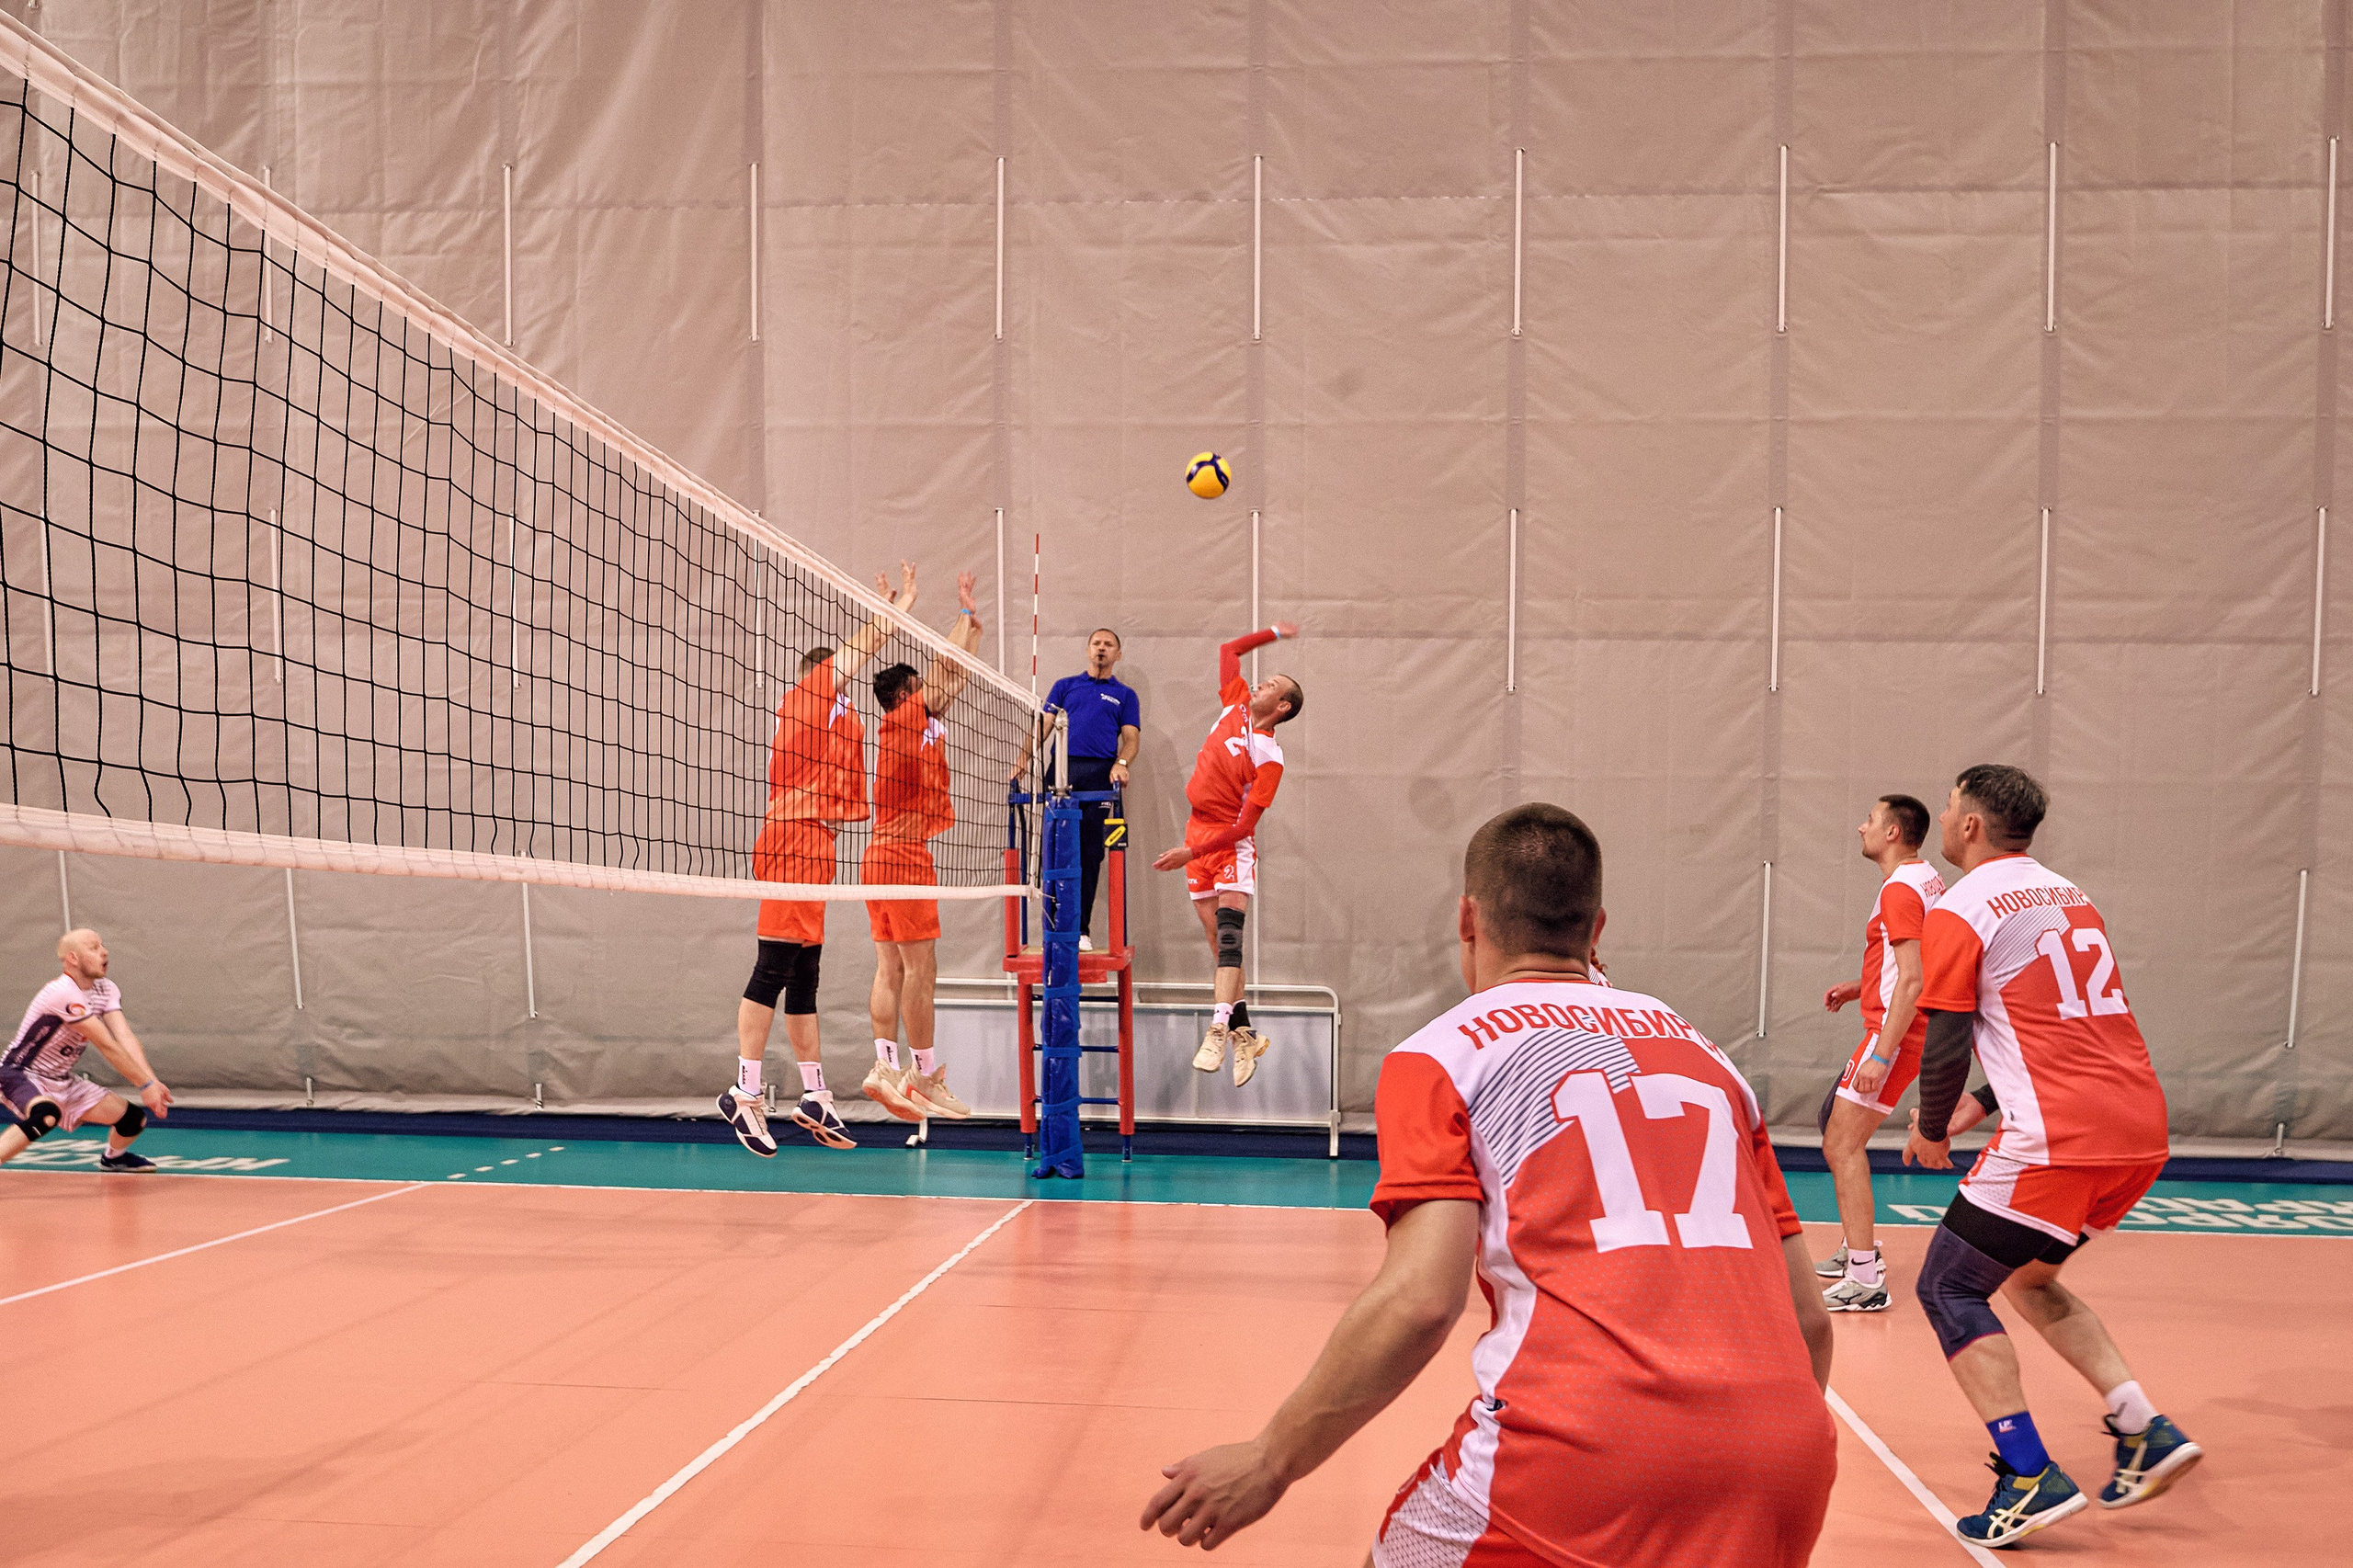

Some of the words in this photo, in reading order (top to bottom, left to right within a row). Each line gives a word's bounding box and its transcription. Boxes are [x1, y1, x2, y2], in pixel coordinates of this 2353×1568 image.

[2035, 927, 2129, 1020] 12
[1457, 1002, 1725, 1061] НОВОСИБИР
[1552, 1069, 1753, 1253] 17
